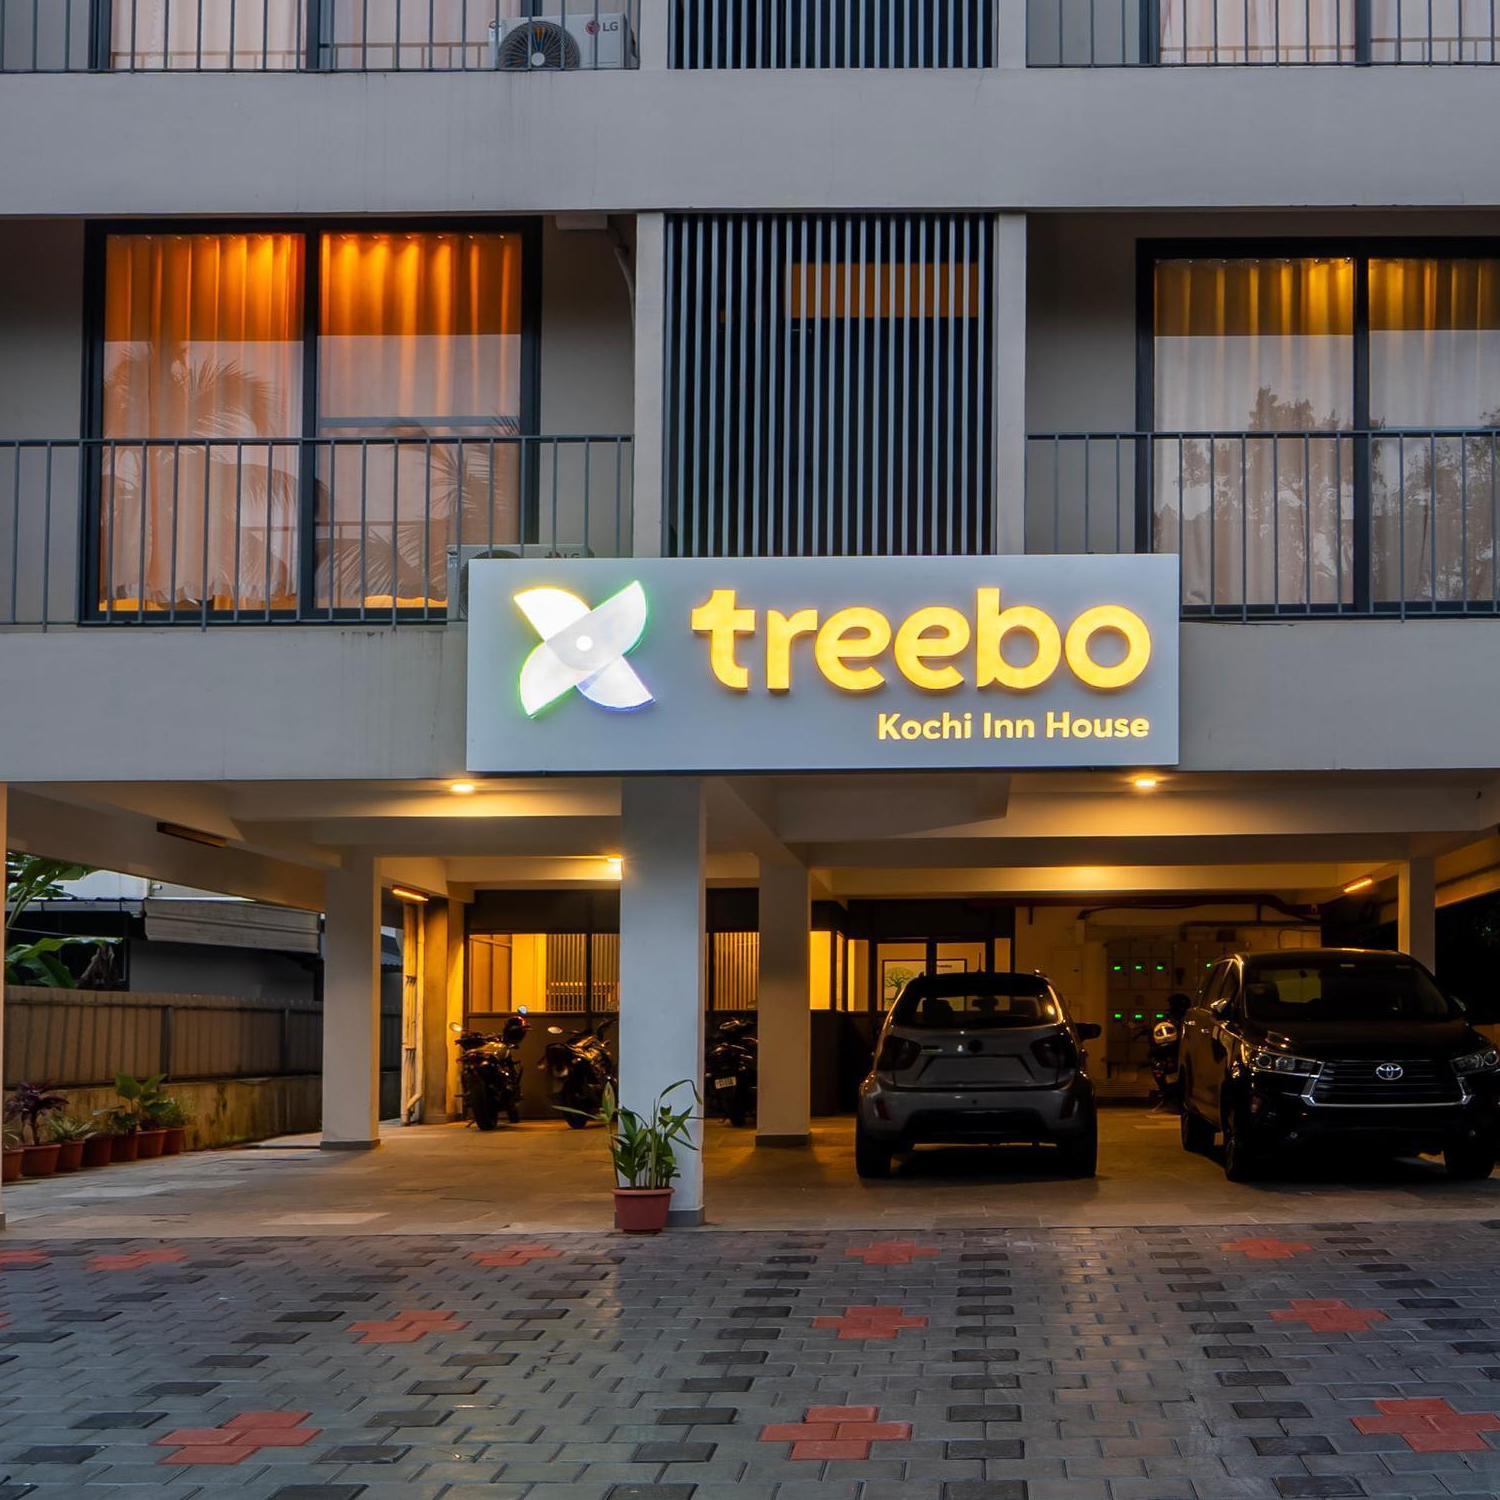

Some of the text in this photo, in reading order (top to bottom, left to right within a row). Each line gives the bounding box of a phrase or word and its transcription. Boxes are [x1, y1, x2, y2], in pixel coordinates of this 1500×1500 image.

[602, 21, 619, 32] LG
[691, 587, 1153, 691] treebo
[877, 710, 1150, 740] Kochi Inn House
